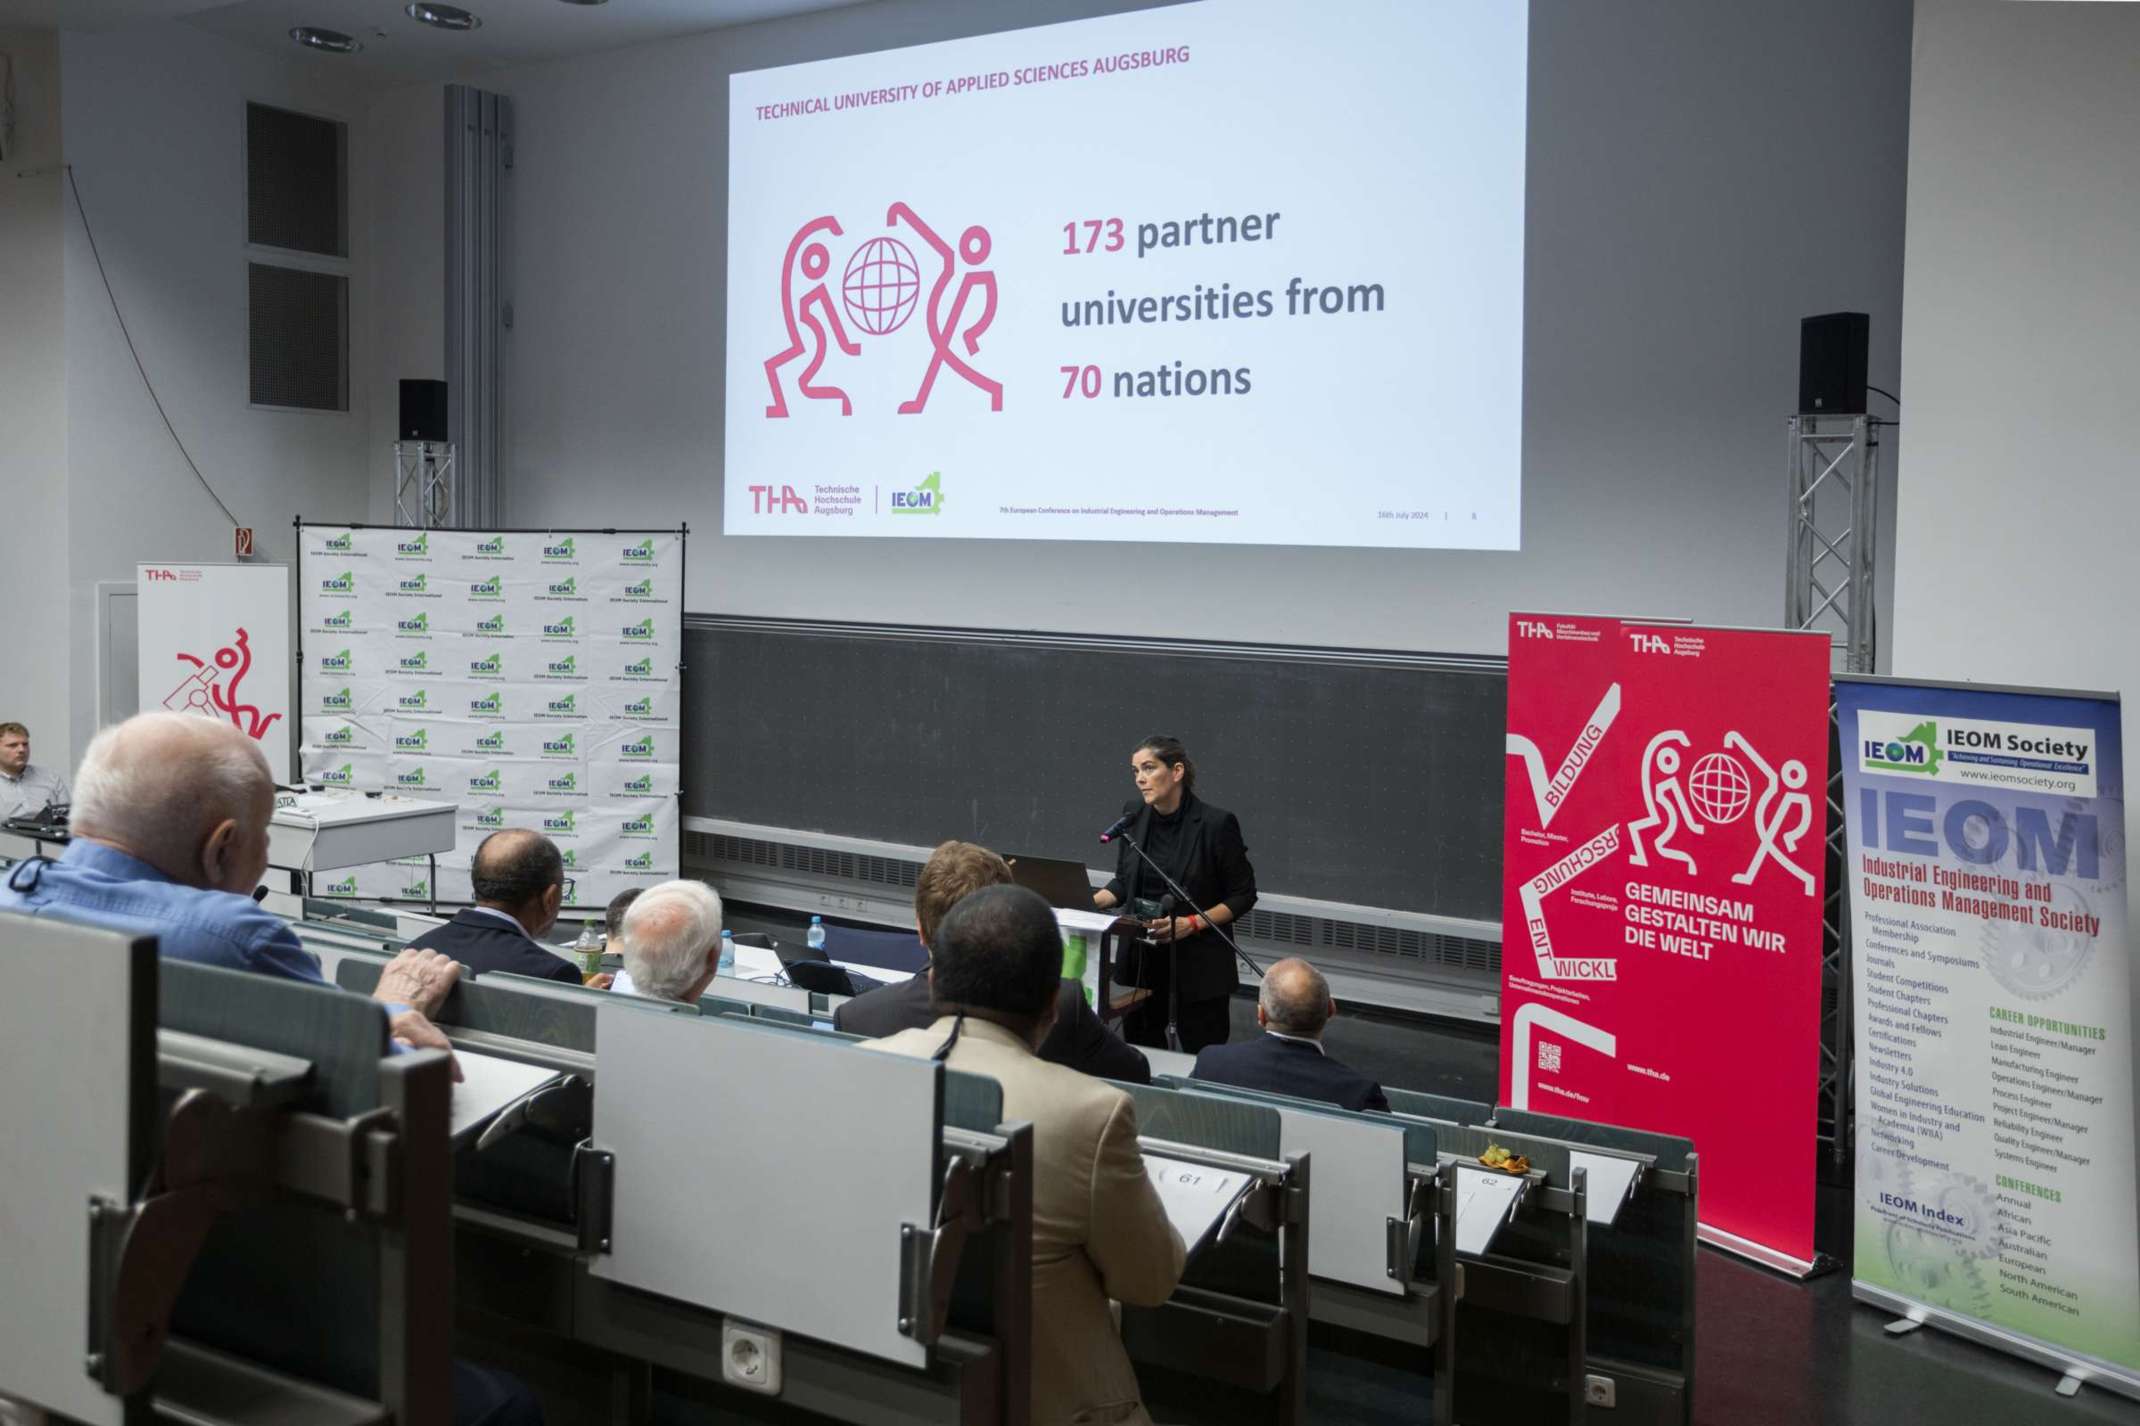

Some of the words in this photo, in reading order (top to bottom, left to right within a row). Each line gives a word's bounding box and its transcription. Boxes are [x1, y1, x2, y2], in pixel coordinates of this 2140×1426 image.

[756, 97, 831, 121] TECHNICAL
[834, 84, 919, 110] UNIVERSITY
[922, 81, 942, 98] OF
[946, 72, 1009, 95] APPLIED
[1013, 59, 1089, 86] SCIENCES
[1092, 45, 1190, 75] AUGSBURG
[1062, 217, 1125, 255] 173
[1137, 212, 1280, 258] partner
[1061, 282, 1273, 327] universities
[1286, 277, 1385, 315] from
[1060, 364, 1102, 399] 70
[1113, 360, 1251, 398] nations
[814, 485, 860, 494] Technische
[814, 495, 862, 504] Hochschule
[891, 491, 932, 508] IEOM
[814, 506, 854, 516] Augsburg
[622, 627, 647, 635] IEOM
[323, 696, 346, 704] IEOM
[471, 701, 495, 709] IEOM
[625, 704, 646, 712] IEOM
[396, 737, 420, 745] IEOM
[543, 742, 567, 750] IEOM
[1864, 740, 1924, 764] IEOM
[1947, 729, 2002, 749] IEOM
[2007, 734, 2088, 761] Society
[323, 772, 346, 780] IEOM
[1543, 723, 1603, 809] BILDUNG
[470, 778, 494, 786] IEOM
[1960, 769, 2076, 792] www.ieomsociety.org
[544, 819, 568, 827] IEOM
[622, 822, 647, 830] IEOM
[1859, 787, 2100, 880] IEOM
[327, 884, 351, 892] IEOM
[1862, 853, 1927, 883] Industrial
[1933, 864, 2020, 900] Engineering
[2025, 881, 2052, 902] and
[401, 887, 422, 895] IEOM
[1625, 881, 1754, 922] GEMEINSAM
[1863, 876, 1936, 908] Operations
[1942, 889, 2034, 924] Management
[2040, 907, 2100, 937] Society
[1625, 904, 1738, 943] GESTALTEN
[1742, 928, 1786, 954] WIR
[1865, 911, 1909, 928] Professional
[1911, 921, 1957, 937] Association
[1872, 926, 1919, 944] Membership
[1530, 918, 1552, 961] ENT
[1624, 926, 1656, 949] DIE
[1660, 933, 1714, 961] WELT
[1865, 939, 1909, 957] Conferences
[1911, 950, 1926, 960] and
[1927, 951, 1980, 969] Symposiums
[1866, 954, 1895, 969] Journals
[1553, 960, 1614, 978] WICKL
[1866, 968, 1894, 984] Student
[1896, 976, 1949, 994] Competitions
[1867, 983, 1895, 999] Student
[1896, 990, 1931, 1006] Chapters
[1868, 998, 1911, 1017] Professional
[1913, 1008, 1949, 1025] Chapters
[1868, 1012, 1894, 1028] Awards
[1895, 1022, 1910, 1032] and
[1911, 1023, 1942, 1038] Fellows
[1989, 1006, 2024, 1025] CAREER
[2027, 1014, 2107, 1041] OPPORTUNITIES
[1868, 1027, 1917, 1048] Certifications
[1990, 1026, 2025, 1040] Industrial
[2026, 1033, 2096, 1056] Engineer/Manager
[1869, 1041, 1912, 1062] Newsletters
[2009, 1044, 2041, 1060] Engineer
[1869, 1056, 1899, 1075] Industry
[1900, 1066, 1914, 1077] 4.0
[1991, 1056, 2044, 1078] Manufacturing
[2045, 1069, 2079, 1084] Engineer
[1869, 1071, 1900, 1089] Industry
[1901, 1081, 1939, 1097] Solutions
[1991, 1071, 2031, 1089] Operations
[2031, 1081, 2103, 1105] Engineer/Manager
[1870, 1085, 1893, 1101] Global
[1894, 1092, 1943, 1116] Engineering
[1944, 1104, 1985, 1123] Education
[1993, 1102, 2018, 1116] Project
[2019, 1094, 2052, 1109] Engineer
[1870, 1100, 1898, 1117] Women
[1899, 1109, 1908, 1120] in
[1909, 1111, 1943, 1129] Industry
[1944, 1121, 1961, 1133] and
[1878, 1115, 1915, 1134] Academia
[1871, 1127, 1915, 1150] Networking
[1993, 1118, 2029, 1136] Reliability
[2031, 1128, 2063, 1143] Engineer
[1994, 1132, 2020, 1148] Quality
[1896, 1149, 1950, 1172] Development
[1994, 1148, 2025, 1164] Systems
[2025, 1156, 2057, 1173] Engineer
[1179, 1173, 1201, 1185] 61
[1481, 1177, 1498, 1186] 62
[1995, 1174, 2063, 1203] CONFERENCES
[1880, 1192, 1917, 1213] IEOM
[1922, 1204, 1965, 1227] Index
[1996, 1193, 2032, 1209] Annual
[1997, 1208, 2032, 1225] African
[1997, 1223, 2018, 1237] Asia
[2019, 1229, 2052, 1246] Pacific
[1998, 1239, 2048, 1260] Australian
[1999, 1253, 2046, 1275] European
[1999, 1269, 2028, 1285] North
[2030, 1278, 2078, 1300] American
[1999, 1283, 2029, 1299] South
[2031, 1294, 2080, 1317] American
